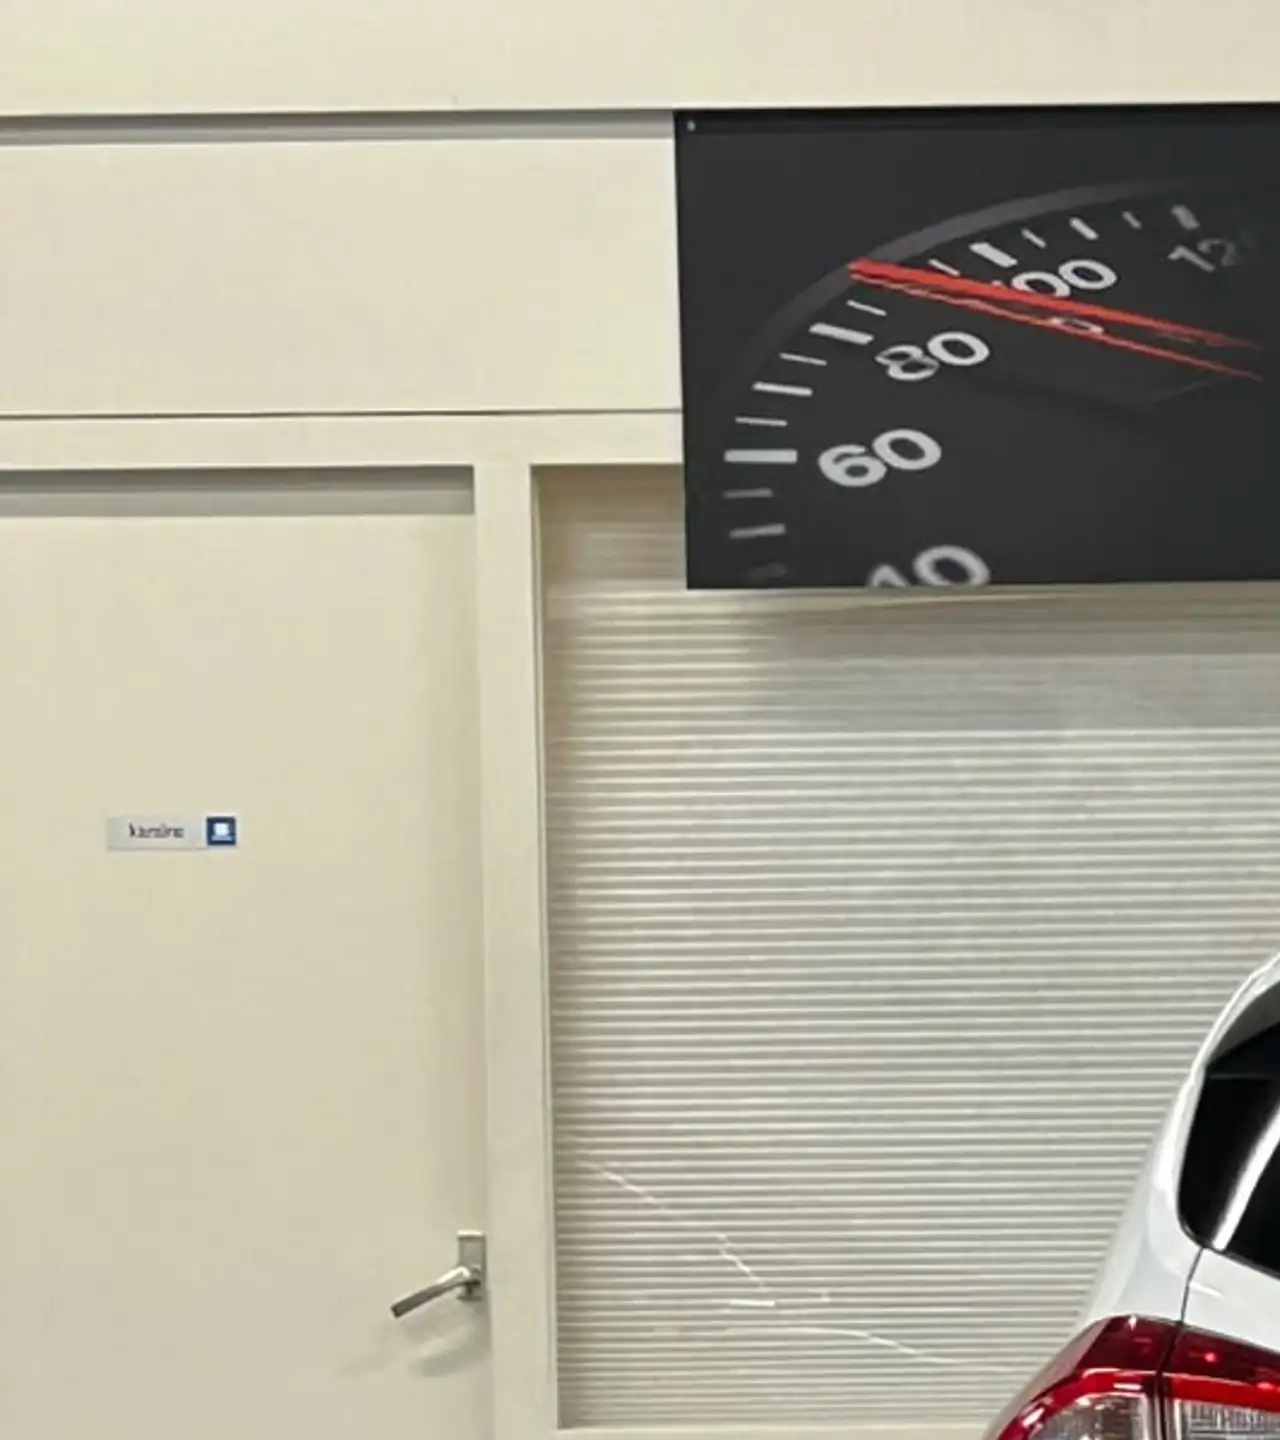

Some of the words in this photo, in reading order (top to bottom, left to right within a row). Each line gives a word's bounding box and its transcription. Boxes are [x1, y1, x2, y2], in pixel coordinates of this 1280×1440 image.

[990, 258, 1118, 304] 00
[876, 331, 990, 381] 80
[818, 428, 942, 488] 60
